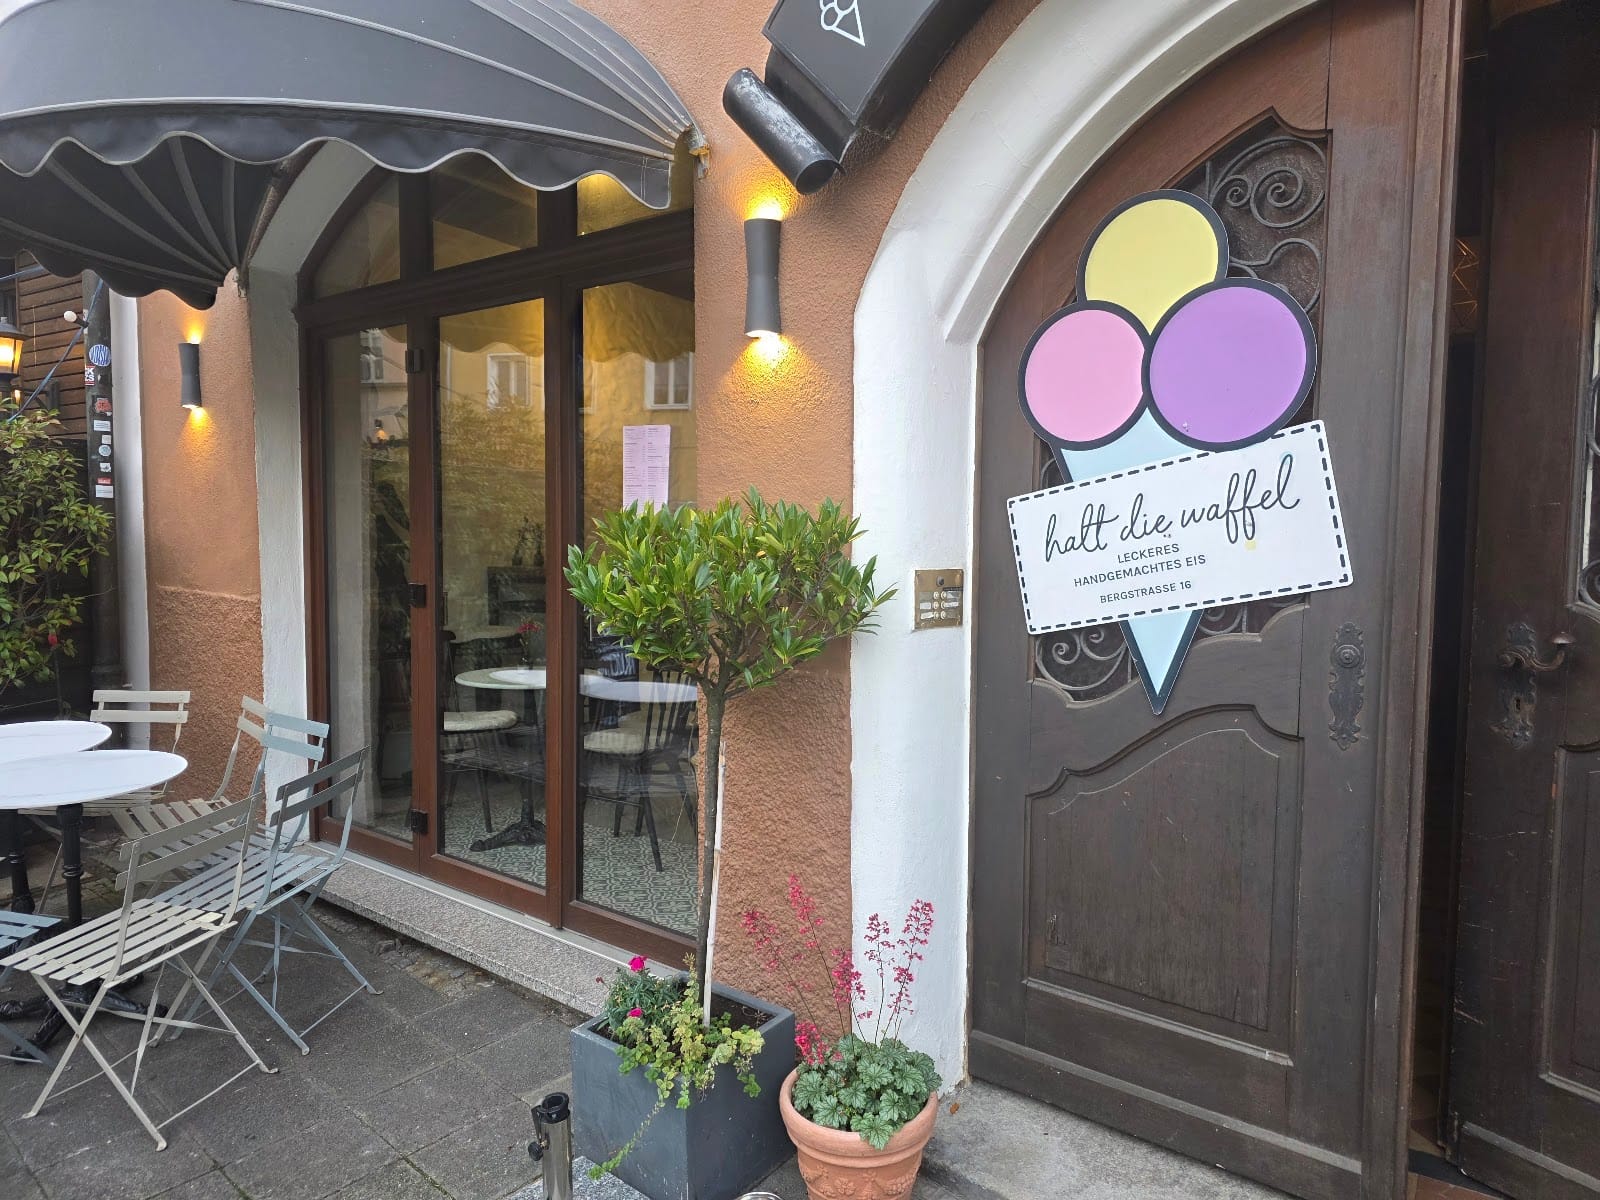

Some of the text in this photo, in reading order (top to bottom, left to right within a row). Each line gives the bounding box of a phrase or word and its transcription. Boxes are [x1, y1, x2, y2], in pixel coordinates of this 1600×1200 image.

[1046, 454, 1300, 562] halt die waffel
[1117, 543, 1180, 564] LECKERES
[1073, 554, 1207, 587] HANDGEMACHTES EIS
[1100, 580, 1192, 604] BERGSTRASSE 16
